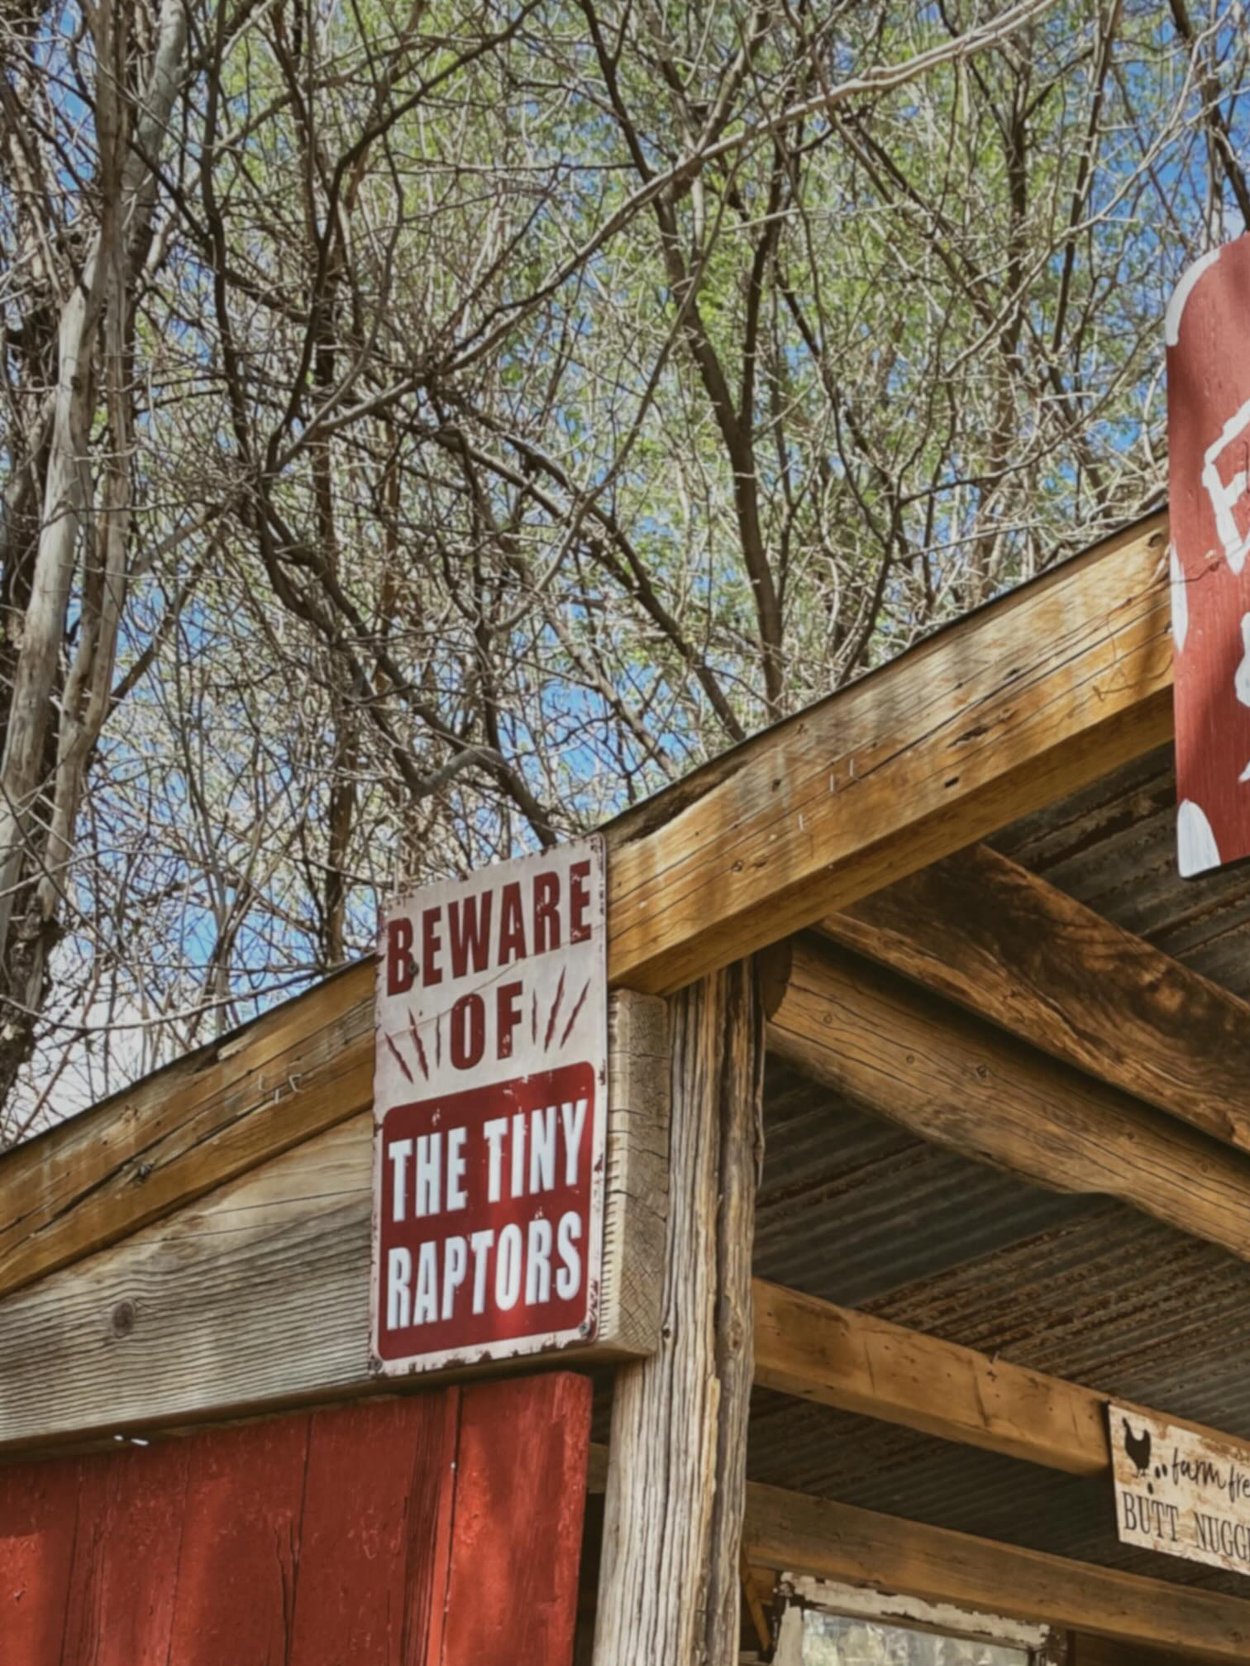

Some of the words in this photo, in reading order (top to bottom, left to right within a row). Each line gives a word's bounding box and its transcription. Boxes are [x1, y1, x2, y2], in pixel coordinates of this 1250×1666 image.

[386, 859, 593, 997] BEWARE
[449, 980, 523, 1071] OF
[388, 1125, 468, 1222] THE
[483, 1099, 589, 1203] TINY
[386, 1211, 583, 1331] RAPTORS
[1121, 1490, 1179, 1542] BUTT
[1171, 1446, 1226, 1490] farm
